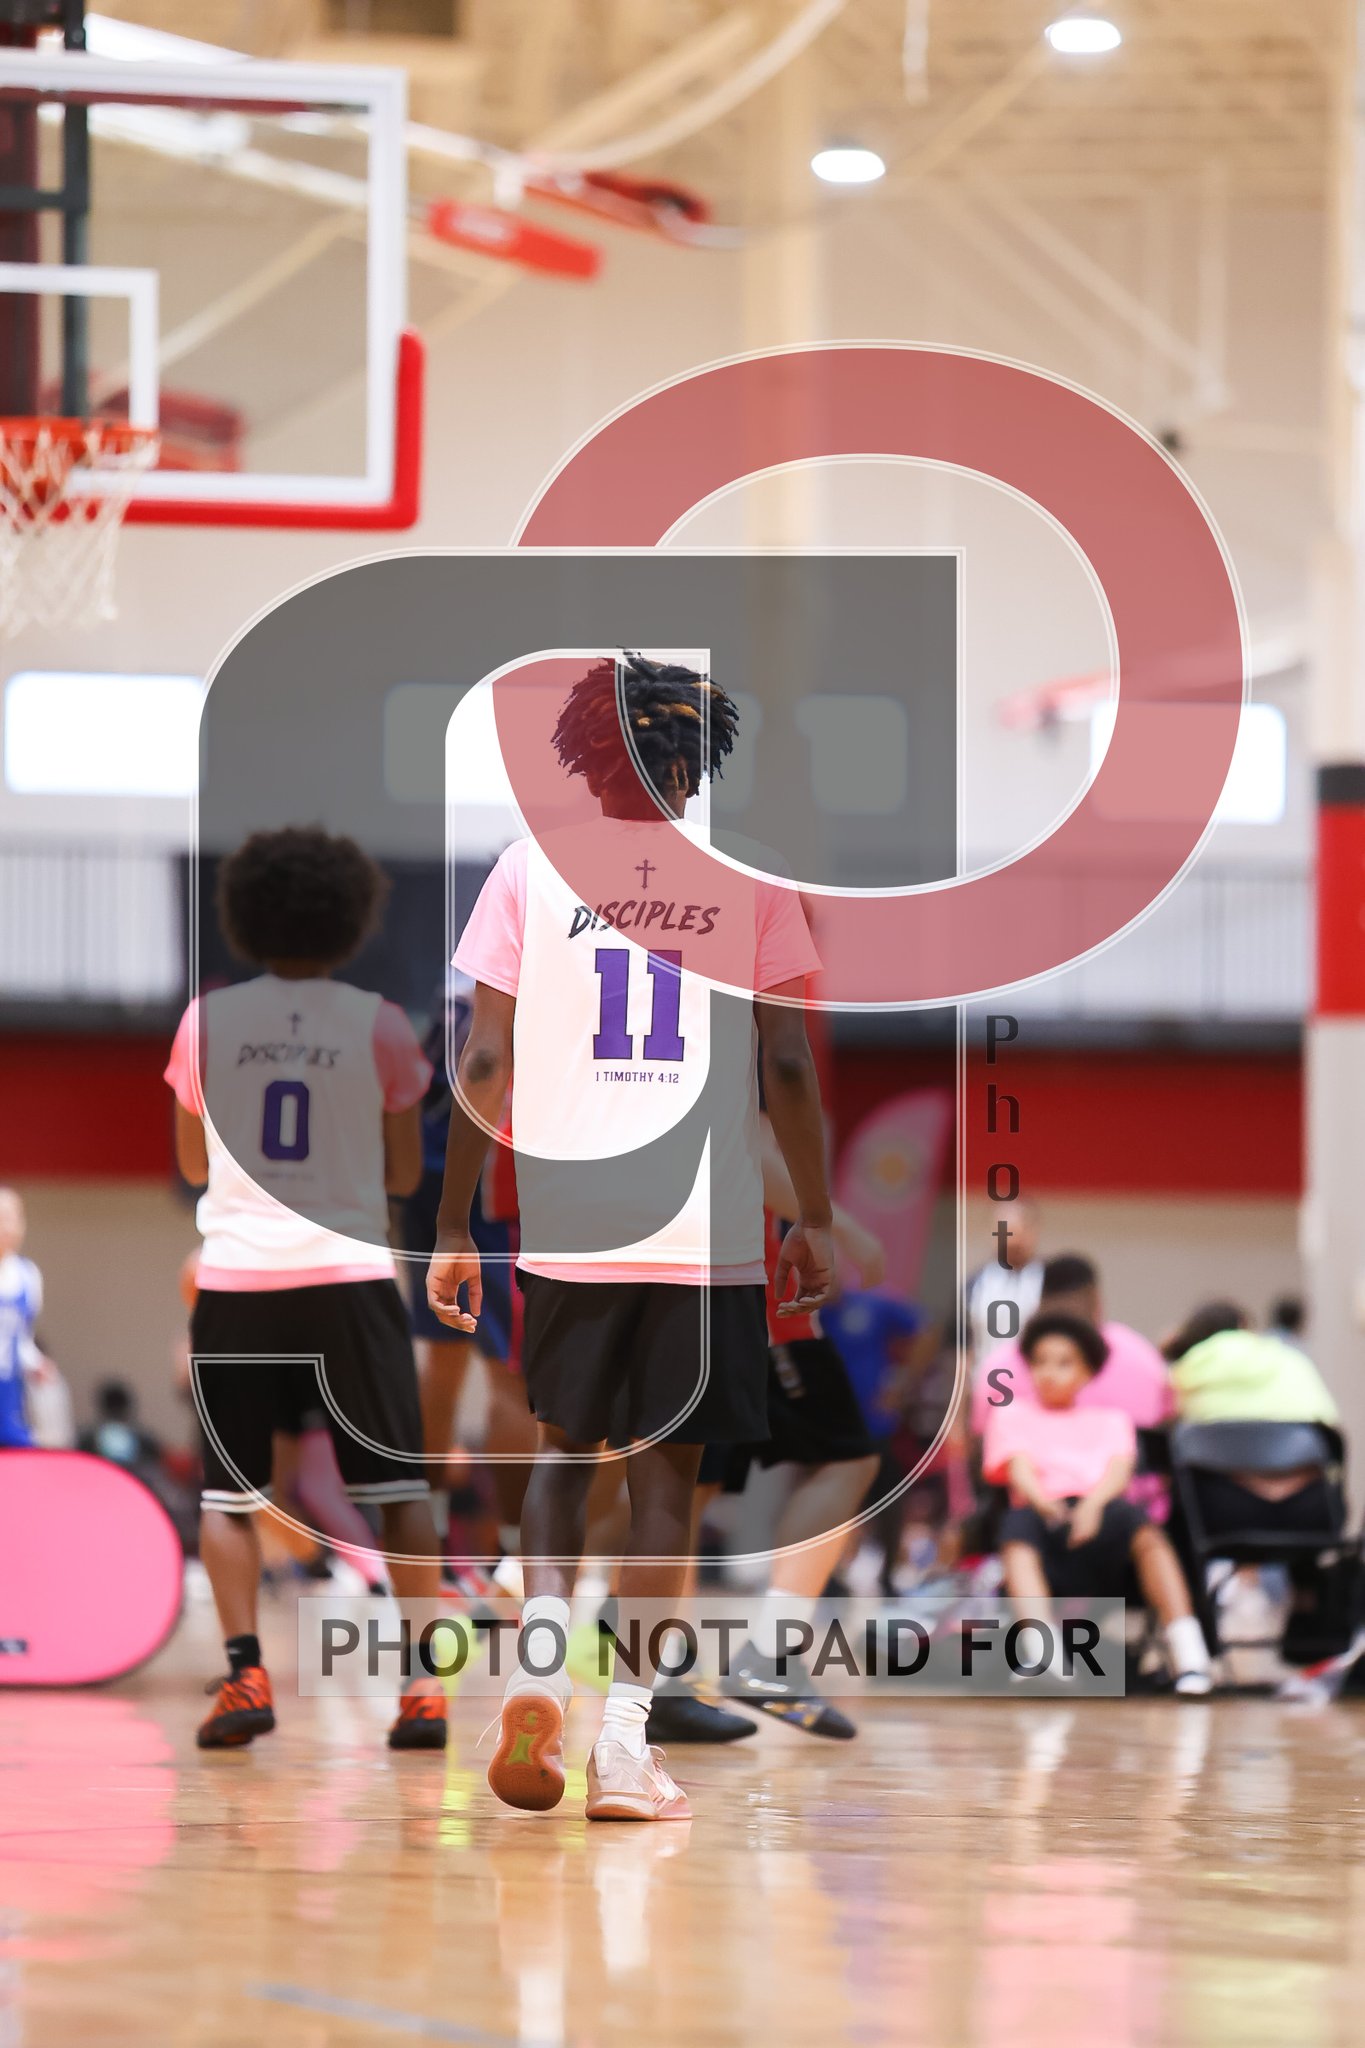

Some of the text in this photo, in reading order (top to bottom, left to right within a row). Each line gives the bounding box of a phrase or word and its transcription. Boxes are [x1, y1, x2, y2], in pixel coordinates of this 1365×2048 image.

[567, 900, 721, 940] DISCIPLES
[593, 948, 685, 1062] 11
[603, 1071, 654, 1083] TIMOTHY
[657, 1073, 680, 1084] 4:12
[262, 1080, 310, 1161] 0
